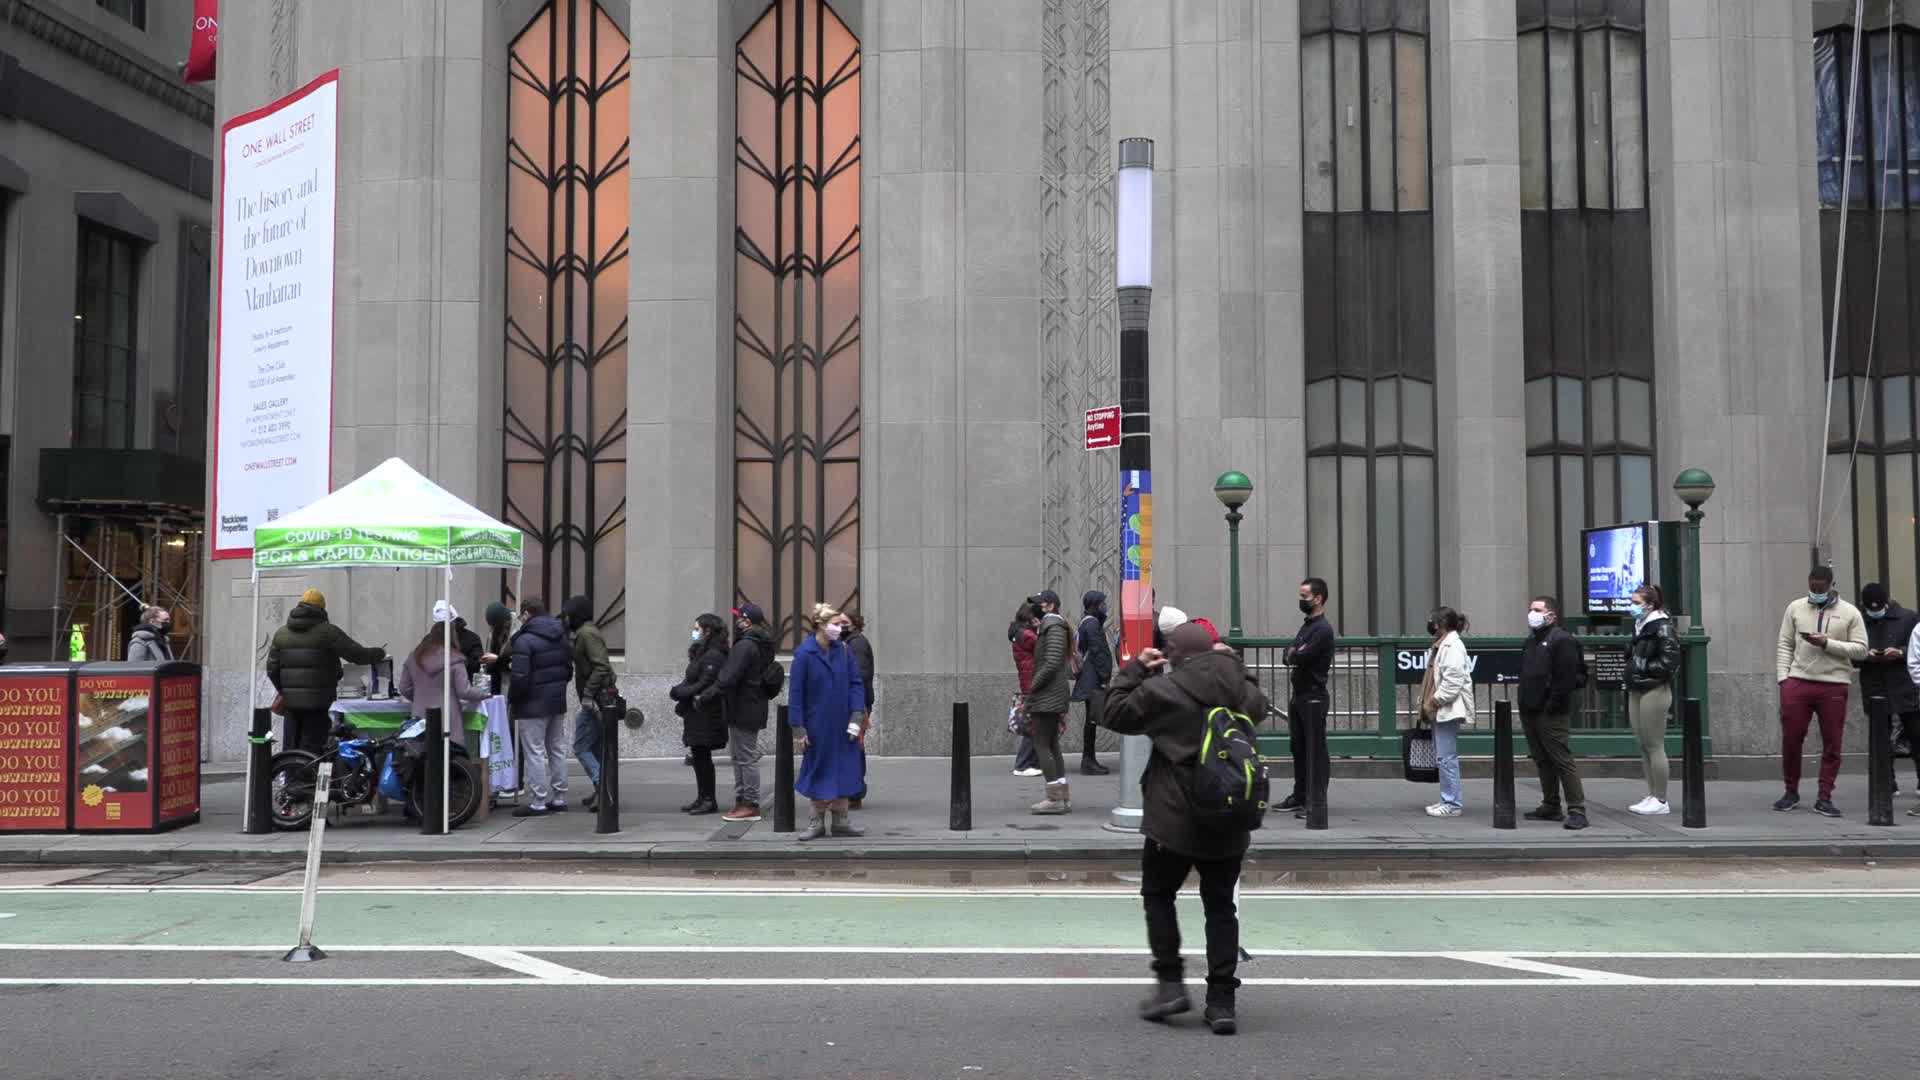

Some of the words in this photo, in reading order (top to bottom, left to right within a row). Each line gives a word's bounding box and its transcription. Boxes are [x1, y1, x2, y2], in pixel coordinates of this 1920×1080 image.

[241, 139, 262, 158] ONE
[265, 131, 287, 149] WALL
[289, 113, 315, 139] STREET
[237, 196, 257, 222] The
[259, 187, 293, 214] history
[297, 167, 318, 199] and
[243, 226, 260, 250] the
[262, 218, 294, 244] future
[296, 206, 308, 231] of
[245, 248, 302, 280] Downtown
[245, 282, 302, 311] Manhattan
[1087, 414, 1093, 422] NO
[1094, 411, 1115, 421] STOPPING
[1088, 422, 1105, 431] Anytime
[221, 523, 248, 534] Properties
[285, 528, 353, 543] COVID-19
[358, 528, 420, 542] TESTING
[258, 551, 293, 565] PCR
[297, 549, 309, 561] &
[313, 547, 366, 561] RAPID
[370, 547, 447, 561] ANTIGEN
[80, 680, 95, 689] DO
[0, 806, 60, 817] OWNTOWN
